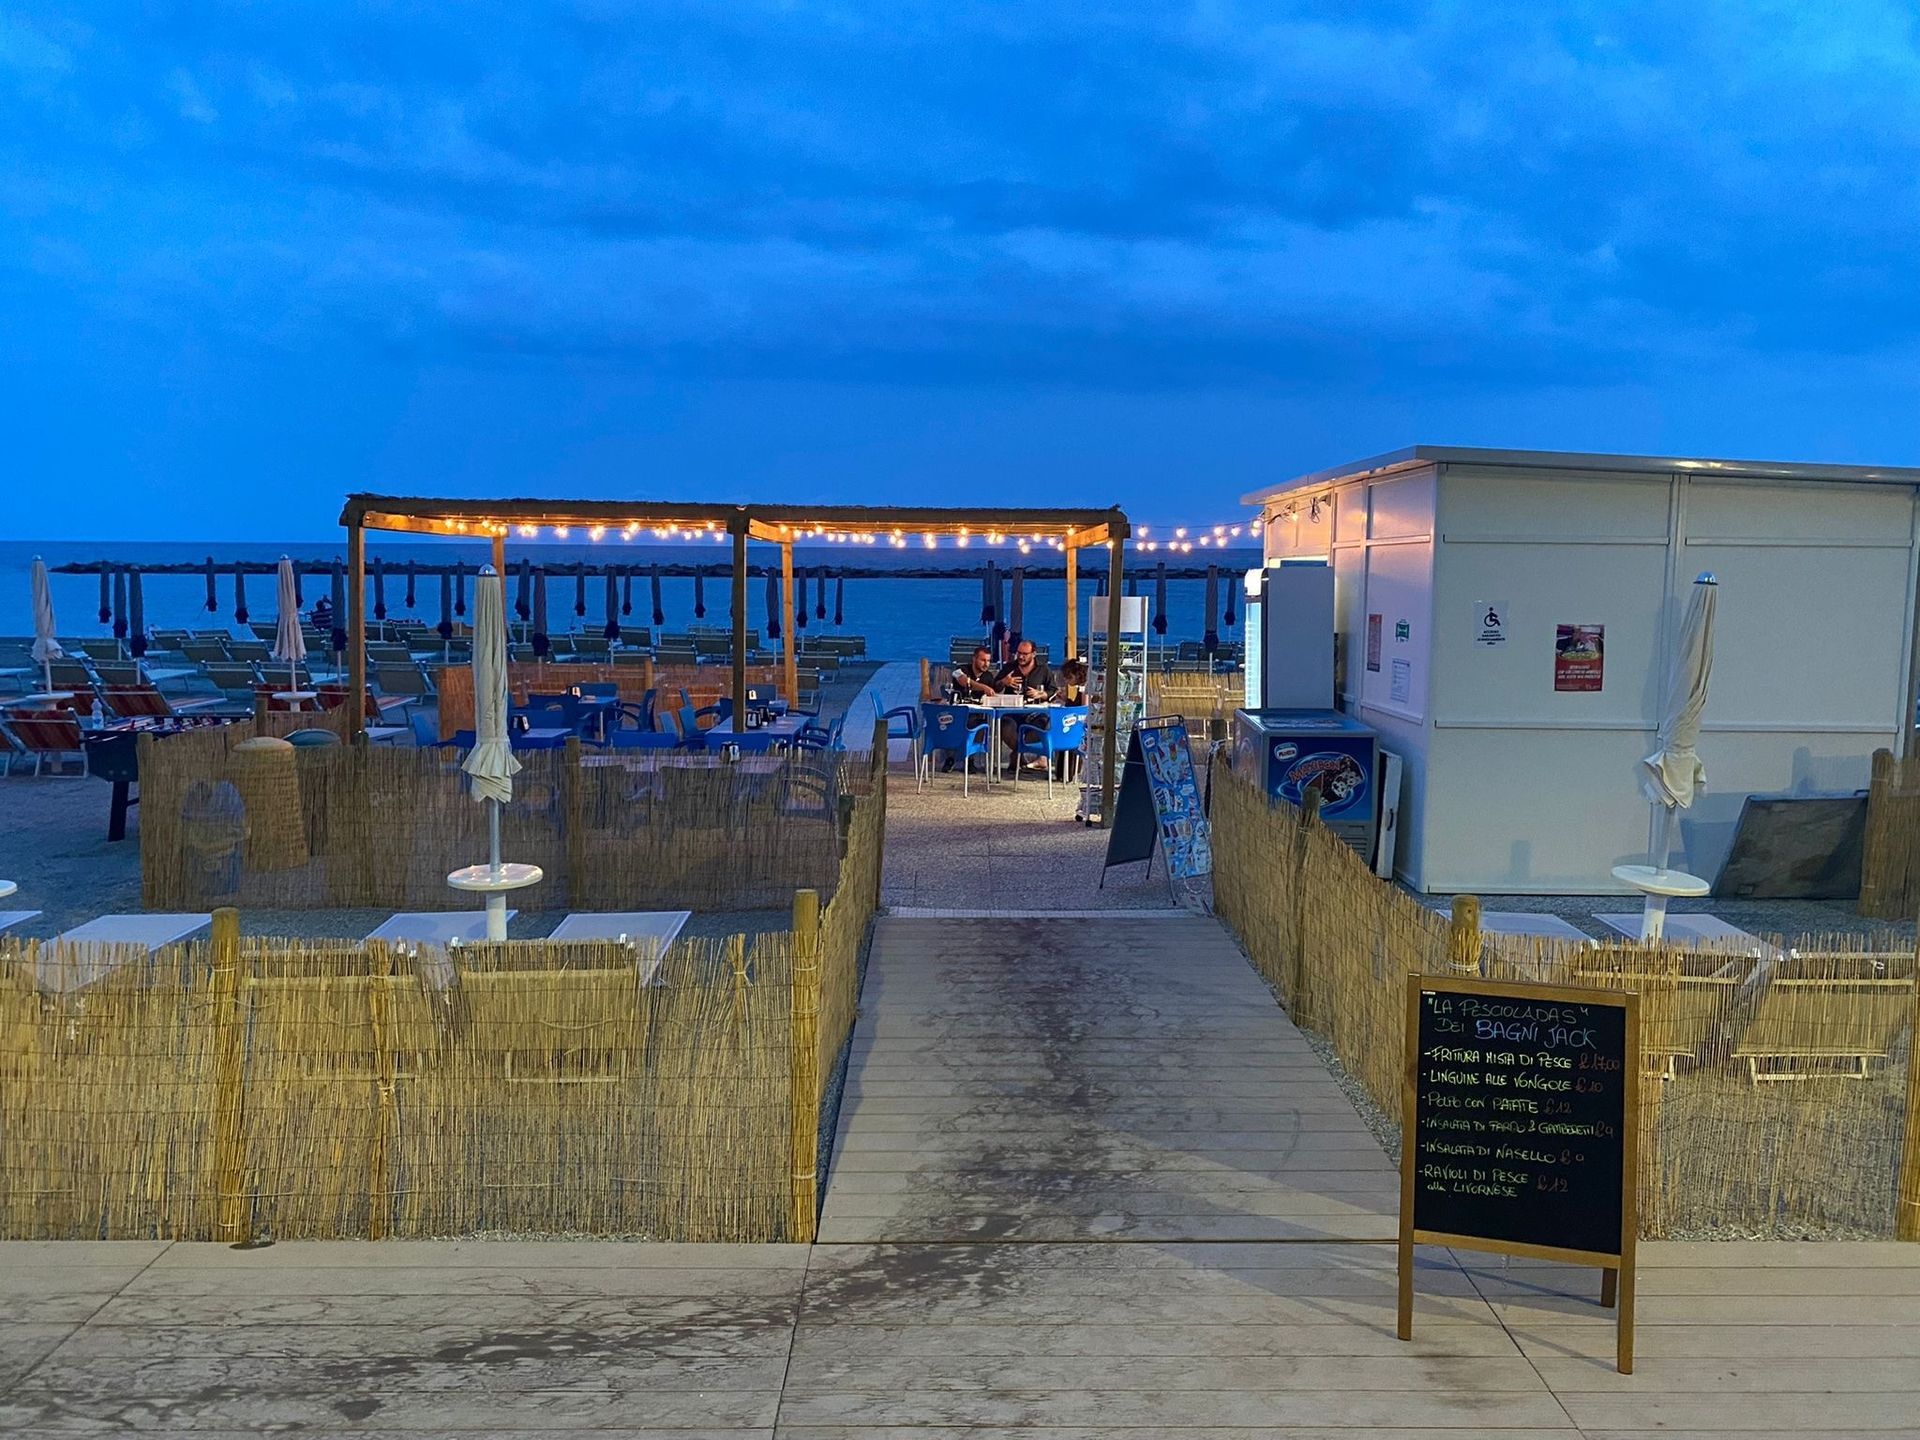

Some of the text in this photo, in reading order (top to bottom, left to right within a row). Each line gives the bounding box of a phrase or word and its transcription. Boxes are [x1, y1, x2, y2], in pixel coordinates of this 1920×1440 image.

[1288, 759, 1341, 784] MAXIBON
[1474, 1019, 1538, 1042] BAGNI
[1543, 1024, 1597, 1050] JACK
[1519, 1053, 1533, 1066] DI
[1537, 1051, 1572, 1069] PESCE
[1485, 1072, 1508, 1085] ALLE
[1514, 1071, 1573, 1091] VONGOLE
[1492, 1097, 1539, 1114] PATATE
[1473, 1120, 1485, 1132] DI
[1476, 1145, 1490, 1156] DI
[1496, 1143, 1556, 1164] NASELLO
[1473, 1168, 1485, 1181] DI
[1492, 1168, 1529, 1184] PESCE
[1453, 1181, 1518, 1197] LIVORNESE
